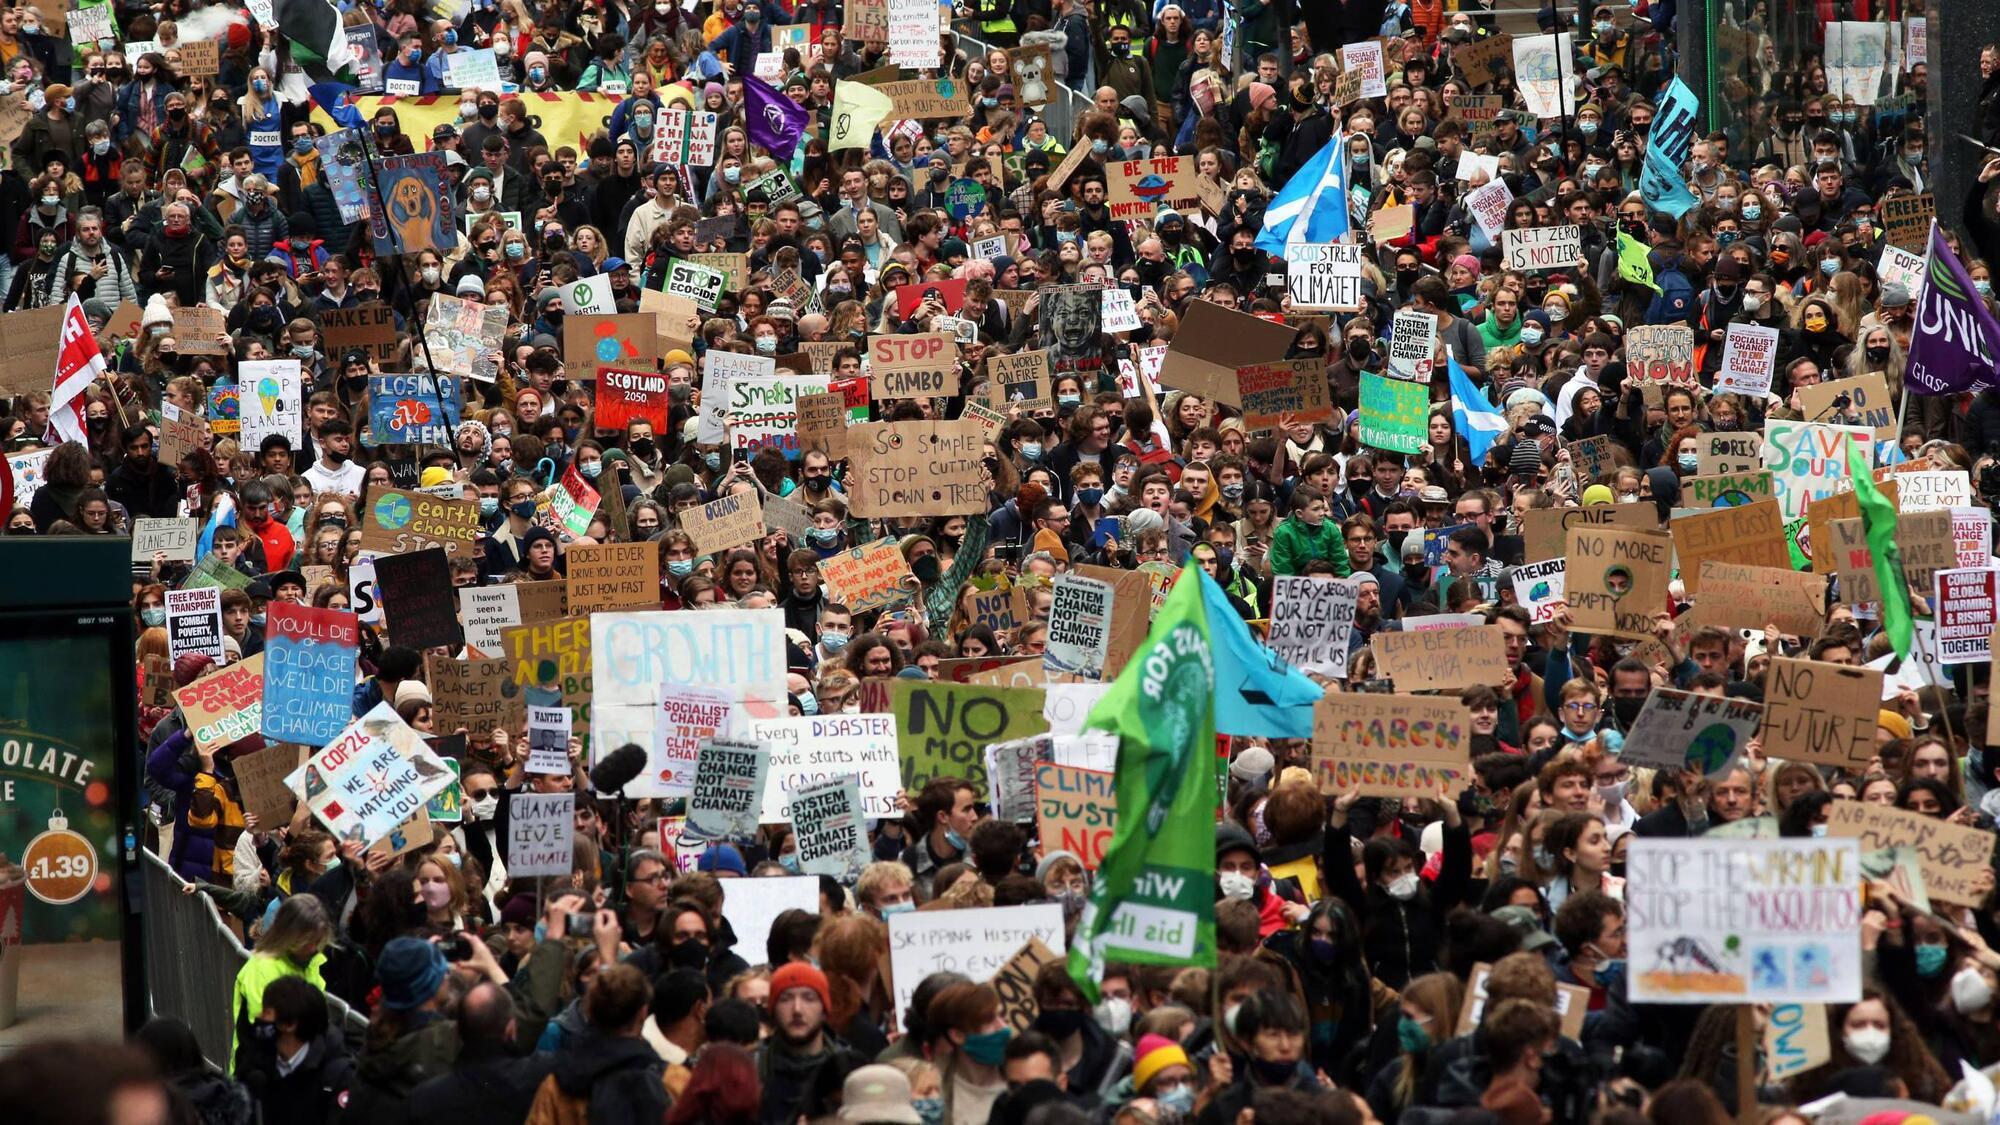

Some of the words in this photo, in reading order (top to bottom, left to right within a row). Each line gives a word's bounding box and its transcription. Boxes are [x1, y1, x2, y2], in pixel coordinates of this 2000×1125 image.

[389, 82, 416, 91] DOCTOR
[1453, 97, 1486, 108] QUIT
[253, 134, 280, 143] DOCTOR
[1123, 161, 1142, 177] BE
[1150, 157, 1180, 174] THE
[1111, 203, 1133, 218] NOT
[1133, 202, 1152, 215] THE
[1885, 200, 1919, 218] FREE
[1510, 228, 1544, 246] NET
[1548, 224, 1582, 242] ZERO
[690, 254, 738, 268] RESPECT
[1290, 244, 1360, 264] SCOTSTREJK
[1511, 252, 1527, 269] IS
[1530, 247, 1556, 266] NOT
[1556, 244, 1582, 263] ZERO
[673, 266, 721, 289] STOP
[670, 282, 718, 302] ECOCIDE
[1288, 275, 1361, 305] KLIMATET
[320, 310, 372, 328] WAKE
[375, 308, 395, 326] UP
[1395, 318, 1431, 332] SYSTEM
[1394, 326, 1431, 340] CHANGE
[1628, 327, 1694, 345] CLIMATE
[1728, 334, 1775, 347] SOCIALIST
[875, 337, 944, 364] STOP
[1393, 342, 1430, 354] CLIMATE
[1627, 343, 1695, 361] ACTION
[1733, 342, 1769, 354] CHANGE
[1012, 354, 1044, 369] WORLD
[1729, 357, 1768, 369] CLIMATE
[1729, 364, 1767, 376] CHANGE
[996, 371, 1014, 385] ON
[1017, 366, 1041, 380] FIRE
[1630, 361, 1695, 384] NOW
[381, 376, 452, 399] LOSING
[606, 373, 666, 393] SCOTLAND
[883, 371, 944, 396] CAMBO
[624, 391, 648, 404] 2050
[732, 382, 793, 407] Smells
[276, 399, 301, 414] OUR
[241, 413, 298, 429] PLANET
[873, 429, 903, 456] SO
[917, 433, 977, 456] SIMPLE
[1709, 437, 1758, 458] BORIS
[1769, 426, 1871, 473] SAVE
[868, 466, 919, 485] STOP
[1791, 460, 1843, 481] OUR
[878, 487, 926, 508] DOWN
[943, 481, 989, 505] TREES
[1694, 477, 1770, 499] REPLANT
[705, 496, 741, 522] OCEANS
[1936, 494, 1964, 506] NOT
[417, 501, 480, 526] earth
[138, 520, 165, 531] THERE
[168, 518, 178, 528] IS
[413, 518, 477, 542] chance
[136, 532, 174, 550] PLANET
[1576, 535, 1605, 557] NO
[1612, 539, 1665, 565] MORE
[570, 549, 600, 564] DOES
[604, 548, 614, 562] IT
[617, 546, 645, 561] EVER
[572, 568, 595, 580] DRIVE
[596, 567, 614, 580] YOU
[614, 565, 645, 579] CRAZY
[1946, 572, 1989, 586] COMBAT
[168, 593, 187, 604] FREE
[187, 590, 218, 603] PUBLIC
[477, 592, 506, 602] haven't
[572, 583, 596, 598] JUST
[599, 582, 620, 596] HOW
[621, 580, 646, 594] FAST
[1055, 586, 1106, 604] SYSTEM
[1276, 579, 1324, 599] EVERY
[1948, 584, 1988, 599] GLOBAL
[170, 601, 216, 614] TRANSPORT
[569, 603, 605, 617] CLIMATE
[976, 593, 1011, 613] NOT
[1054, 598, 1106, 617] CHANGE
[1274, 601, 1302, 621] OUR
[1306, 600, 1356, 622] LEADERS
[1568, 591, 1622, 616] EMPTY
[1944, 596, 1994, 613] WARMING
[178, 615, 211, 627] COMBAT
[469, 617, 490, 628] polar
[1052, 608, 1080, 622] NOT
[1613, 612, 1658, 634] WORDS
[1956, 610, 1992, 624] RISING
[177, 626, 213, 640] POVERTY,
[272, 617, 327, 638] YOU'LL
[329, 623, 354, 642] DIE
[486, 628, 501, 637] but
[1050, 620, 1105, 639] CLIMATE
[1271, 624, 1292, 639] DO
[1296, 623, 1326, 640] NOT
[1329, 626, 1352, 642] ACT
[1941, 622, 1997, 638] INEQUALITY
[173, 636, 212, 650] POLLUTION
[304, 637, 319, 648] OF
[1049, 632, 1100, 649] CHANGE
[1421, 630, 1448, 651] BE
[605, 620, 771, 688] GROWTH
[1329, 648, 1346, 667] US
[436, 661, 471, 679] SAVE
[480, 661, 513, 680] OUR
[269, 670, 317, 691] WE'LL
[322, 678, 349, 695] DIE
[1774, 661, 1815, 700] NO
[286, 699, 350, 721] CLIMATE
[435, 700, 471, 714] SAVE
[474, 700, 505, 714] OUR
[663, 700, 731, 718] SOCIALIST
[908, 688, 1010, 741] NO
[1329, 703, 1367, 717] THIS
[1423, 707, 1457, 721] JUST
[535, 710, 564, 724] WANTED
[670, 713, 723, 728] CHANGE
[266, 716, 341, 739] CHANGE
[754, 723, 801, 746] Every
[1340, 717, 1462, 751] MARCH
[1760, 701, 1874, 763] FUTURE
[320, 730, 373, 772] COP26
[372, 746, 402, 773] ARE
[700, 749, 757, 767] SYSTEM
[810, 750, 854, 765] starts
[860, 747, 895, 764] with
[697, 761, 758, 778] CHANGE
[1316, 758, 1461, 794] MOVEMENT
[342, 774, 362, 795] WE
[695, 773, 725, 786] NOT
[354, 768, 420, 820] WATCHING
[693, 785, 755, 803] CLIMATE
[791, 789, 846, 814] SYSTEM
[386, 796, 421, 822] YOU
[509, 799, 572, 820] CHANGE
[691, 797, 753, 813] CHANGE
[794, 802, 851, 826] CHANGE
[515, 828, 565, 843] LIVE
[796, 823, 823, 839] NOT
[798, 825, 857, 850] CLIMATE
[508, 852, 570, 867] CLIMATE
[800, 838, 857, 864] CHANGE
[30, 856, 89, 881] £1.39
[1630, 849, 1691, 890] STOP
[1701, 849, 1743, 890] THE
[1630, 890, 1691, 932] STOP
[1701, 888, 1743, 930] THE
[893, 927, 974, 949] SKIPPING
